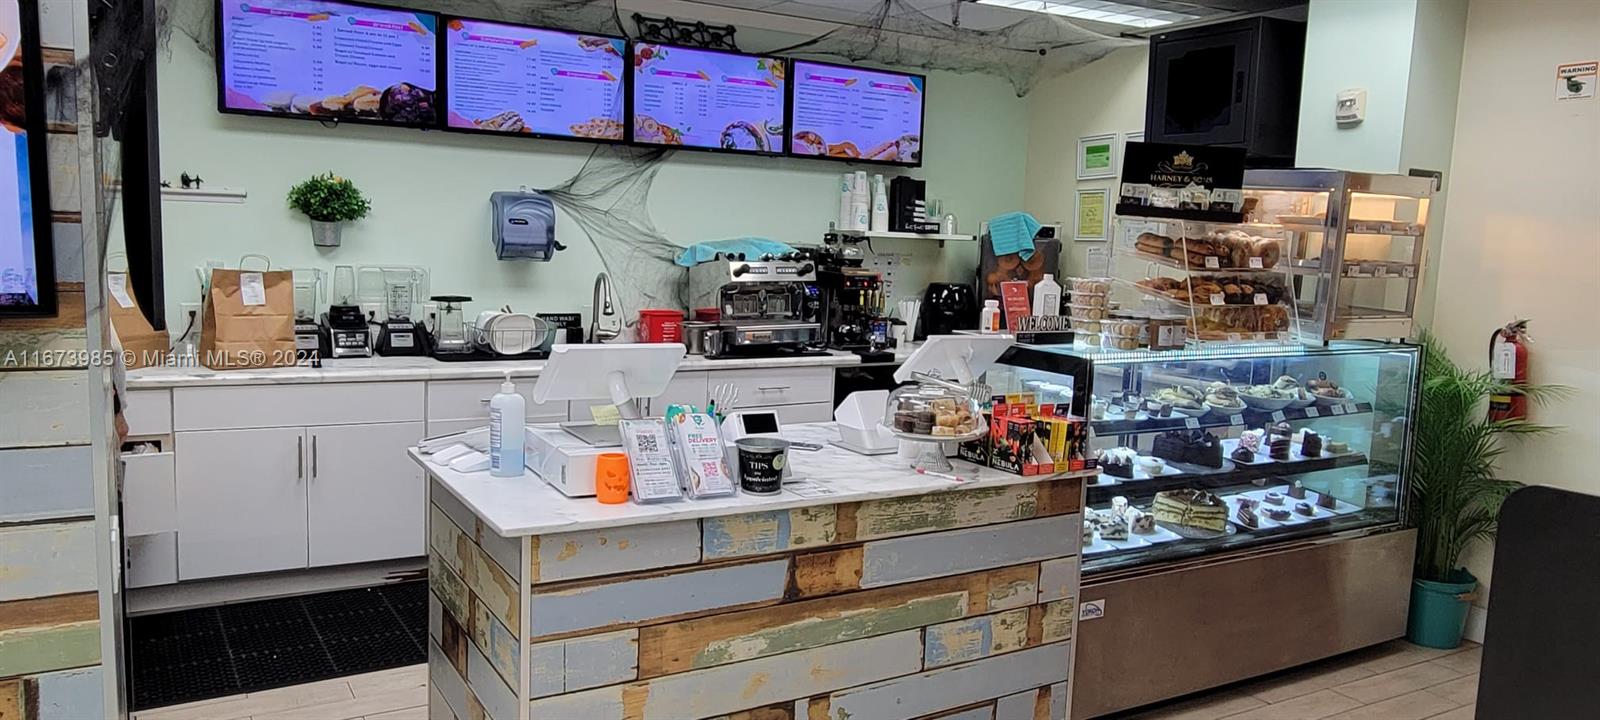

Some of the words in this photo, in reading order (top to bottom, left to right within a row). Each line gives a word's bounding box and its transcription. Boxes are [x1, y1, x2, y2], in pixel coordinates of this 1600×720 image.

[1561, 65, 1597, 74] WARNING
[1150, 173, 1182, 183] HARNEY
[1183, 174, 1190, 183] &
[1192, 175, 1213, 184] SONS
[1017, 315, 1070, 332] WELCOME
[748, 461, 769, 470] TIPS
[992, 455, 1021, 471] NEBULA
